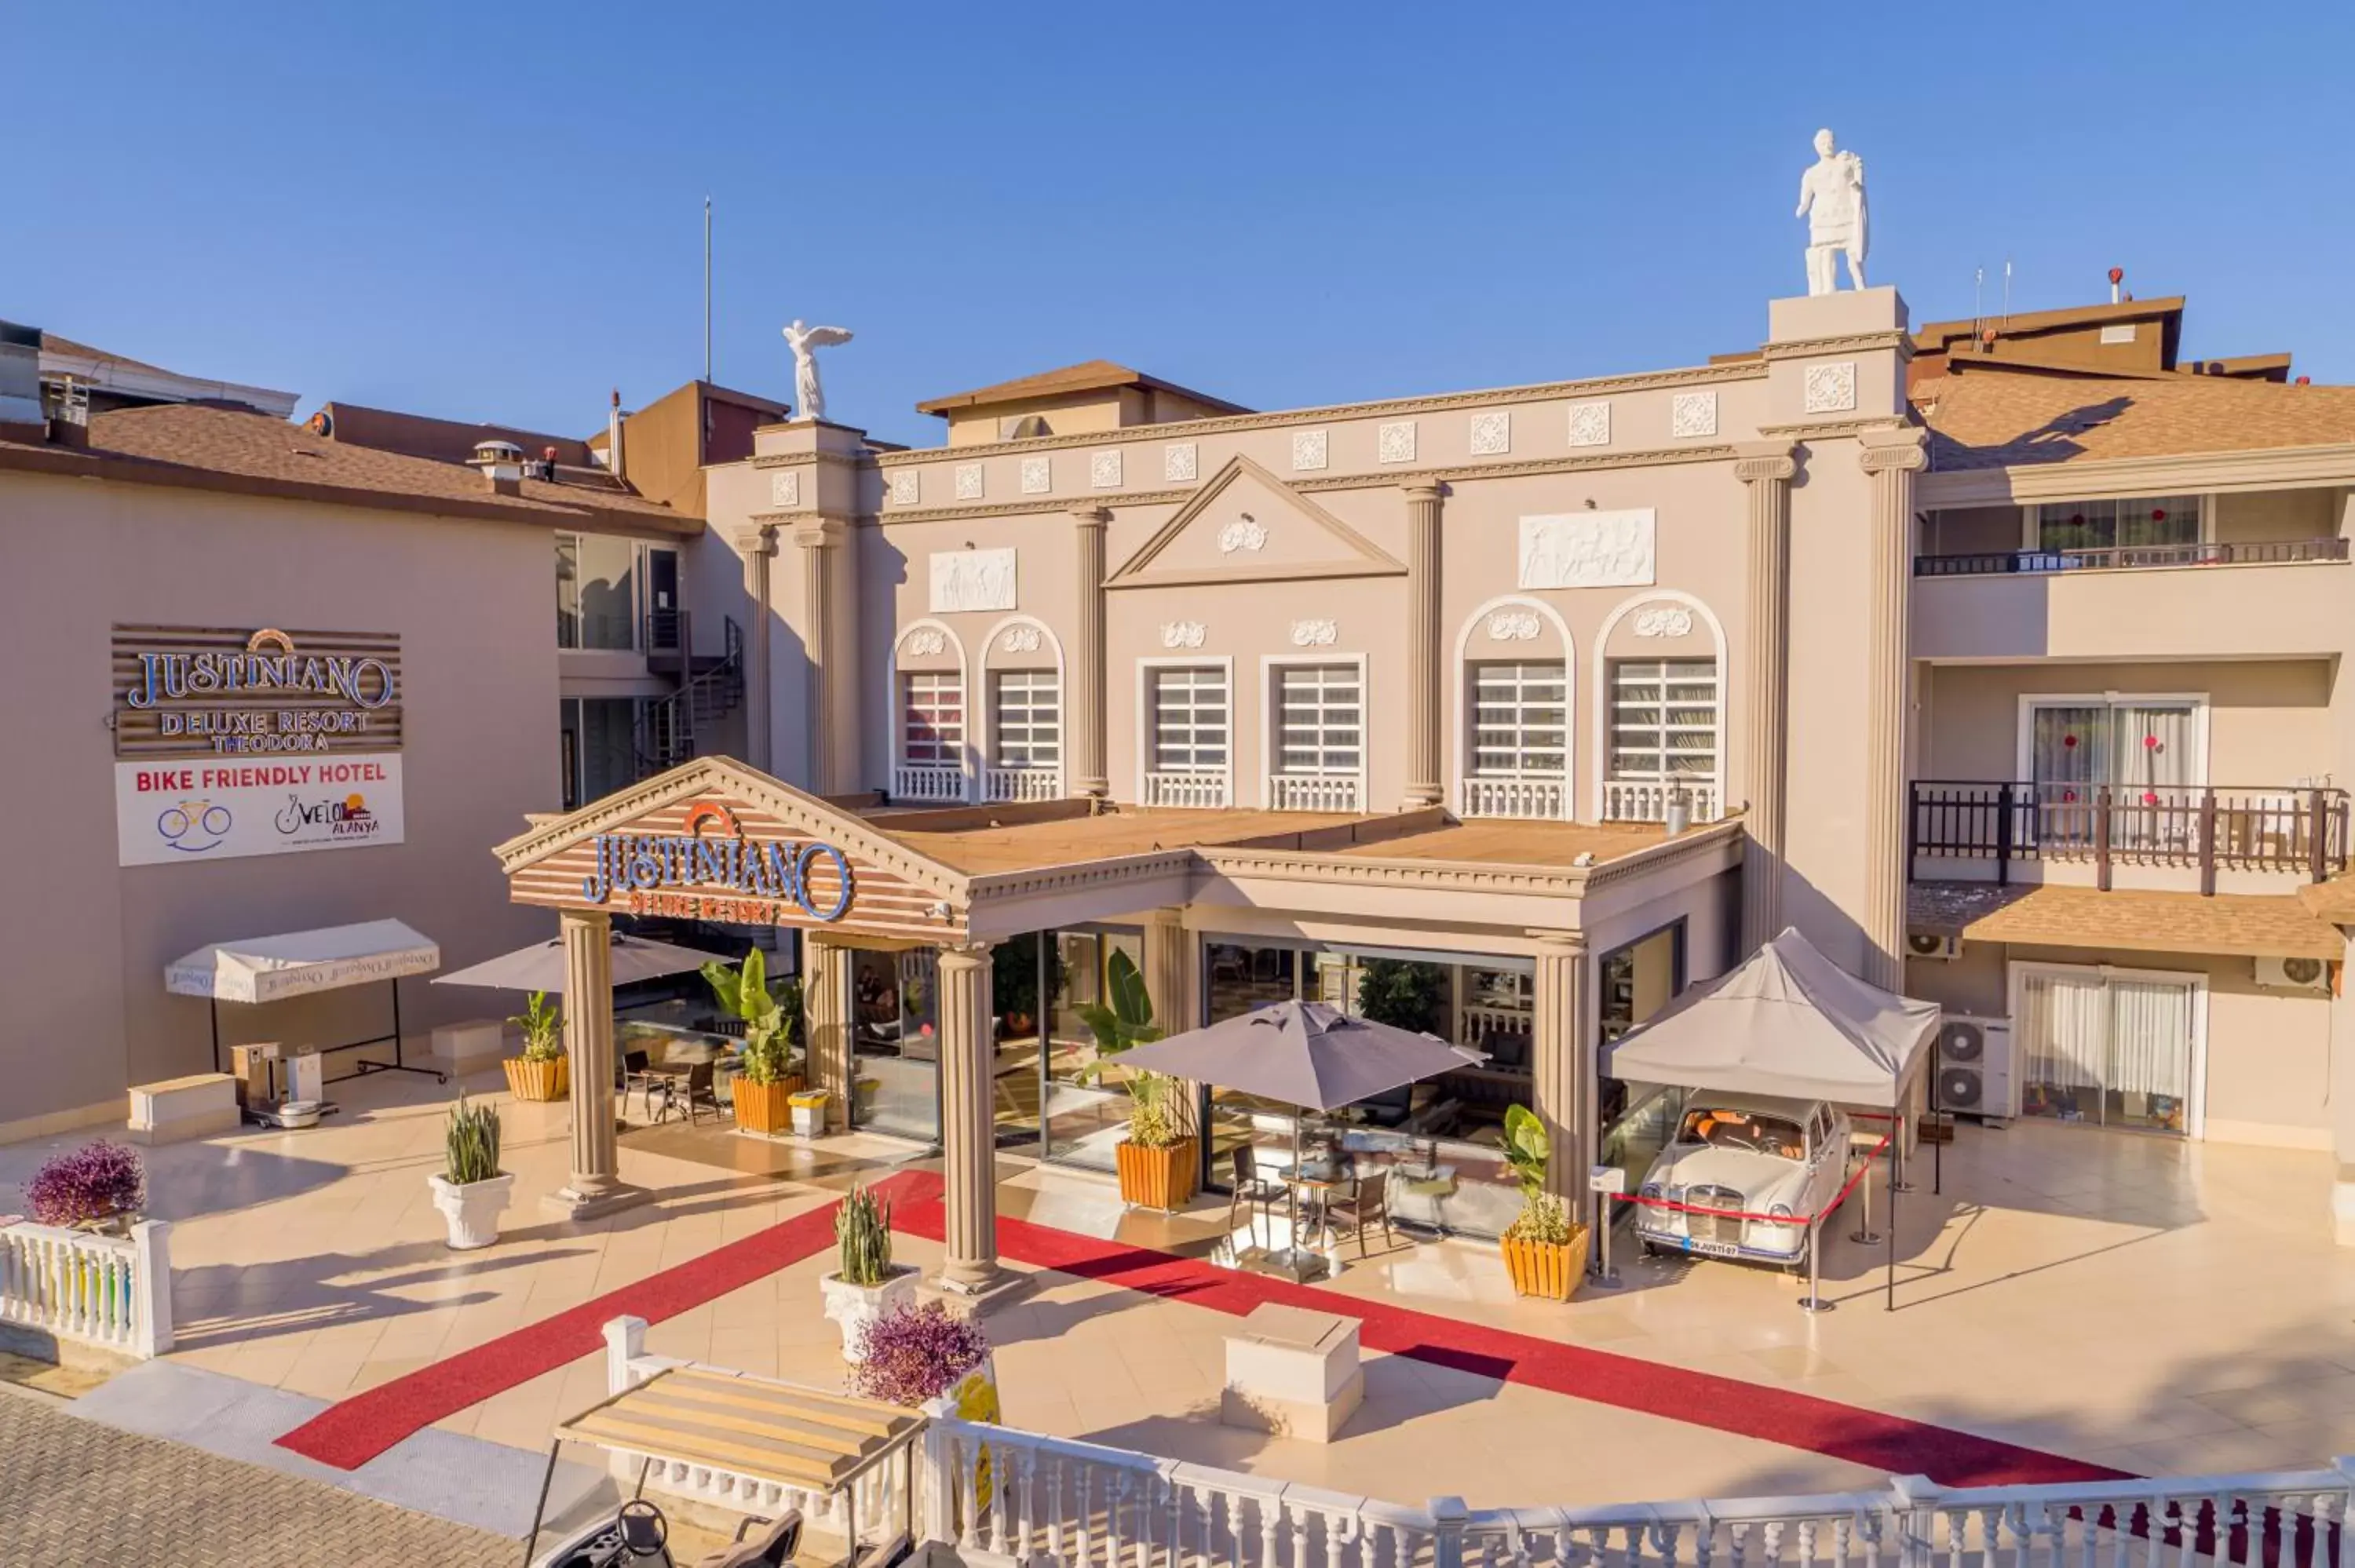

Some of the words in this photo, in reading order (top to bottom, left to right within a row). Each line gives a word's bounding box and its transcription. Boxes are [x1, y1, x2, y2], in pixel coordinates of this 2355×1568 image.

[128, 653, 393, 709] JUSTINIANO
[162, 713, 266, 735] DELUXE
[279, 711, 370, 732] RESORT
[211, 733, 329, 753] THEODORA
[137, 770, 194, 792] BIKE
[203, 765, 312, 789] FRIENDLY
[319, 763, 387, 783] HOTEL
[332, 819, 380, 834] ALANYA
[582, 833, 854, 921] JUSTINIANO
[630, 890, 697, 919] DELUXE
[702, 897, 779, 924] RESORT
